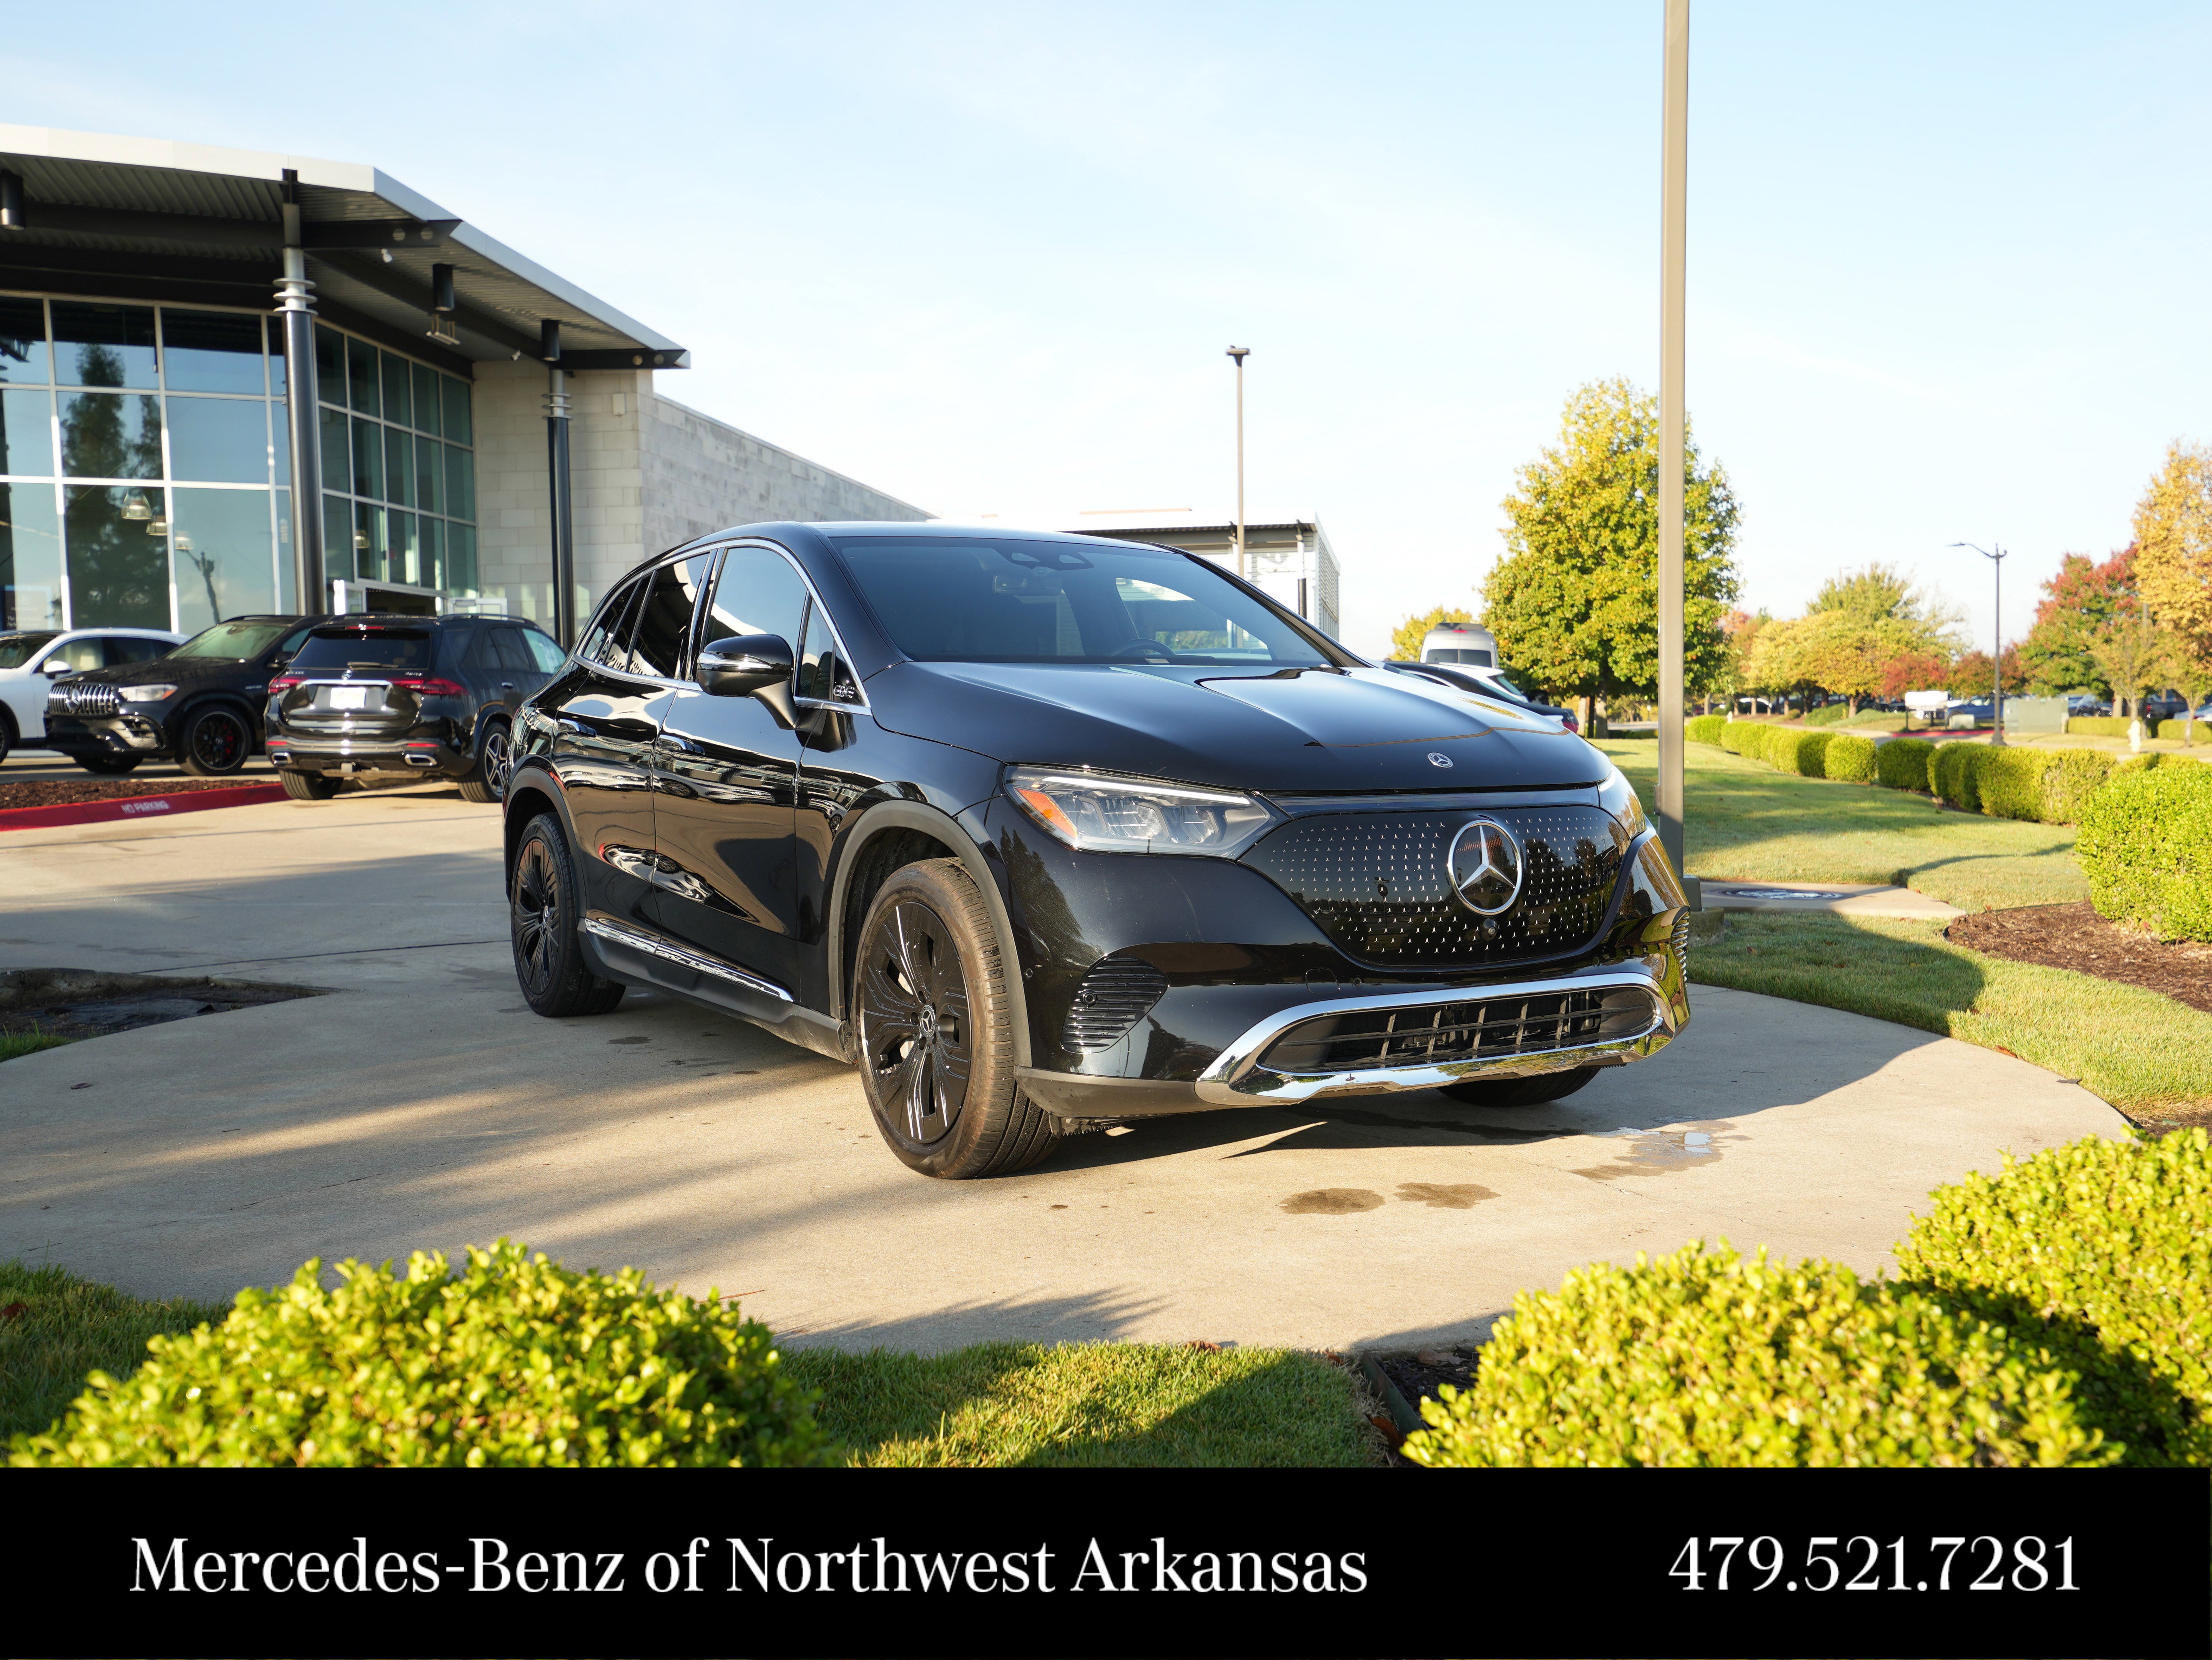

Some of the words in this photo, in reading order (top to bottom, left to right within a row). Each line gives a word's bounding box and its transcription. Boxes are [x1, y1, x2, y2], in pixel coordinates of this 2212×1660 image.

[833, 685, 855, 698] EQE
[121, 803, 135, 814] NO
[133, 800, 169, 812] PARKING
